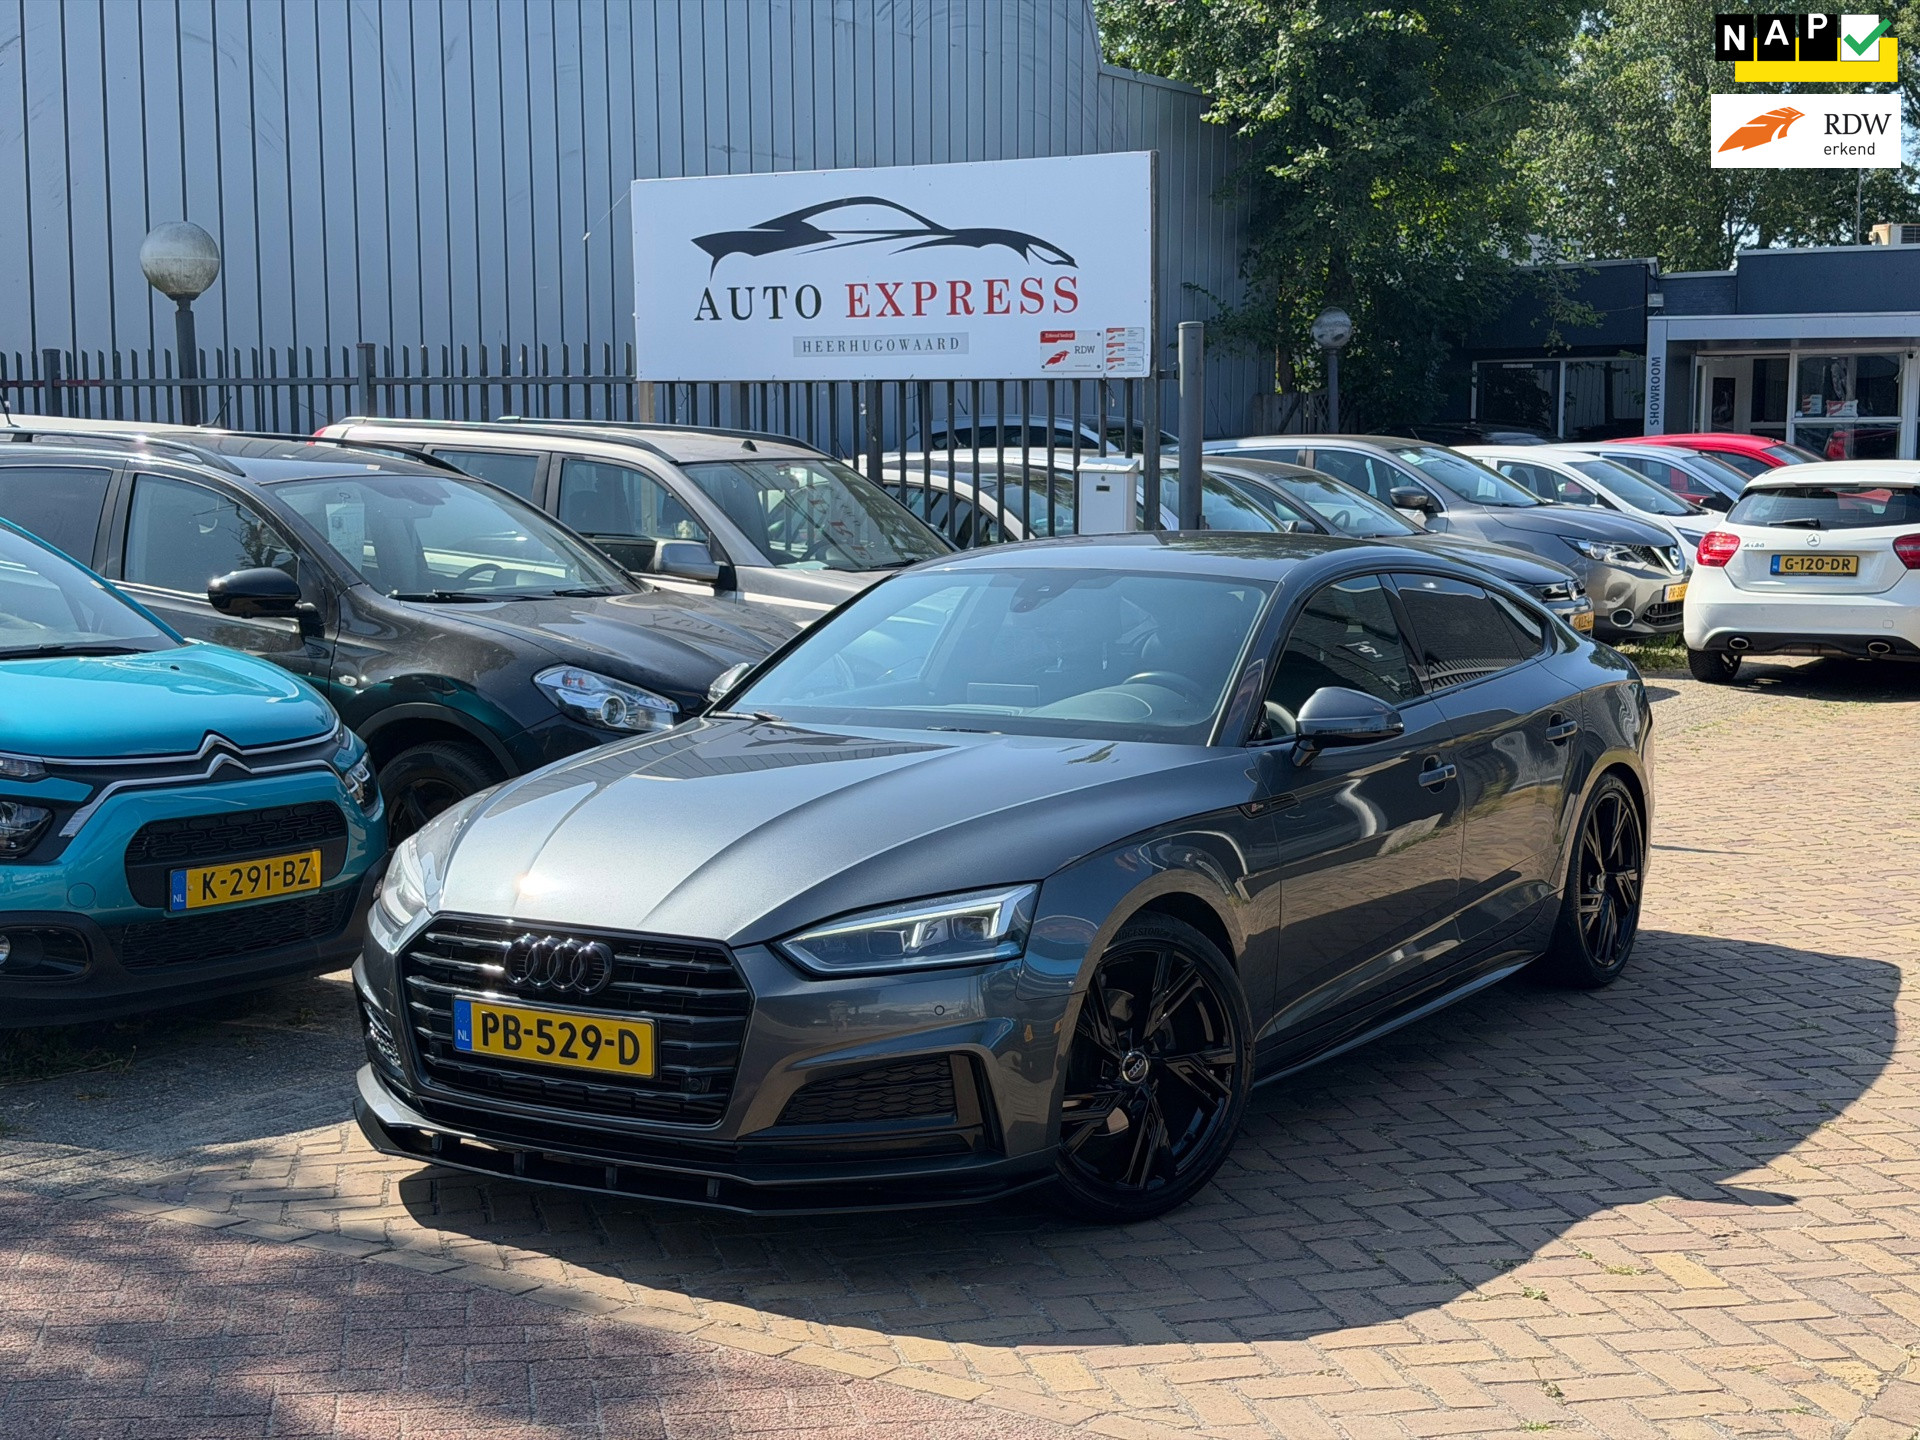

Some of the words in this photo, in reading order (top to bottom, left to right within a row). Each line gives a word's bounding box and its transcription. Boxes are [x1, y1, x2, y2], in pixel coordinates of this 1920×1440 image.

[694, 284, 823, 321] AUTO
[845, 276, 1080, 319] EXPRESS
[802, 336, 961, 354] HEERHUGOWAARD
[1074, 345, 1096, 354] RDW
[1649, 355, 1662, 426] SHOWROOM
[1784, 557, 1851, 571] G-120-DR
[201, 857, 311, 901] K-291-BZ
[172, 894, 185, 904] NL
[457, 1029, 470, 1043] NL
[480, 1010, 640, 1066] PB-529-D
